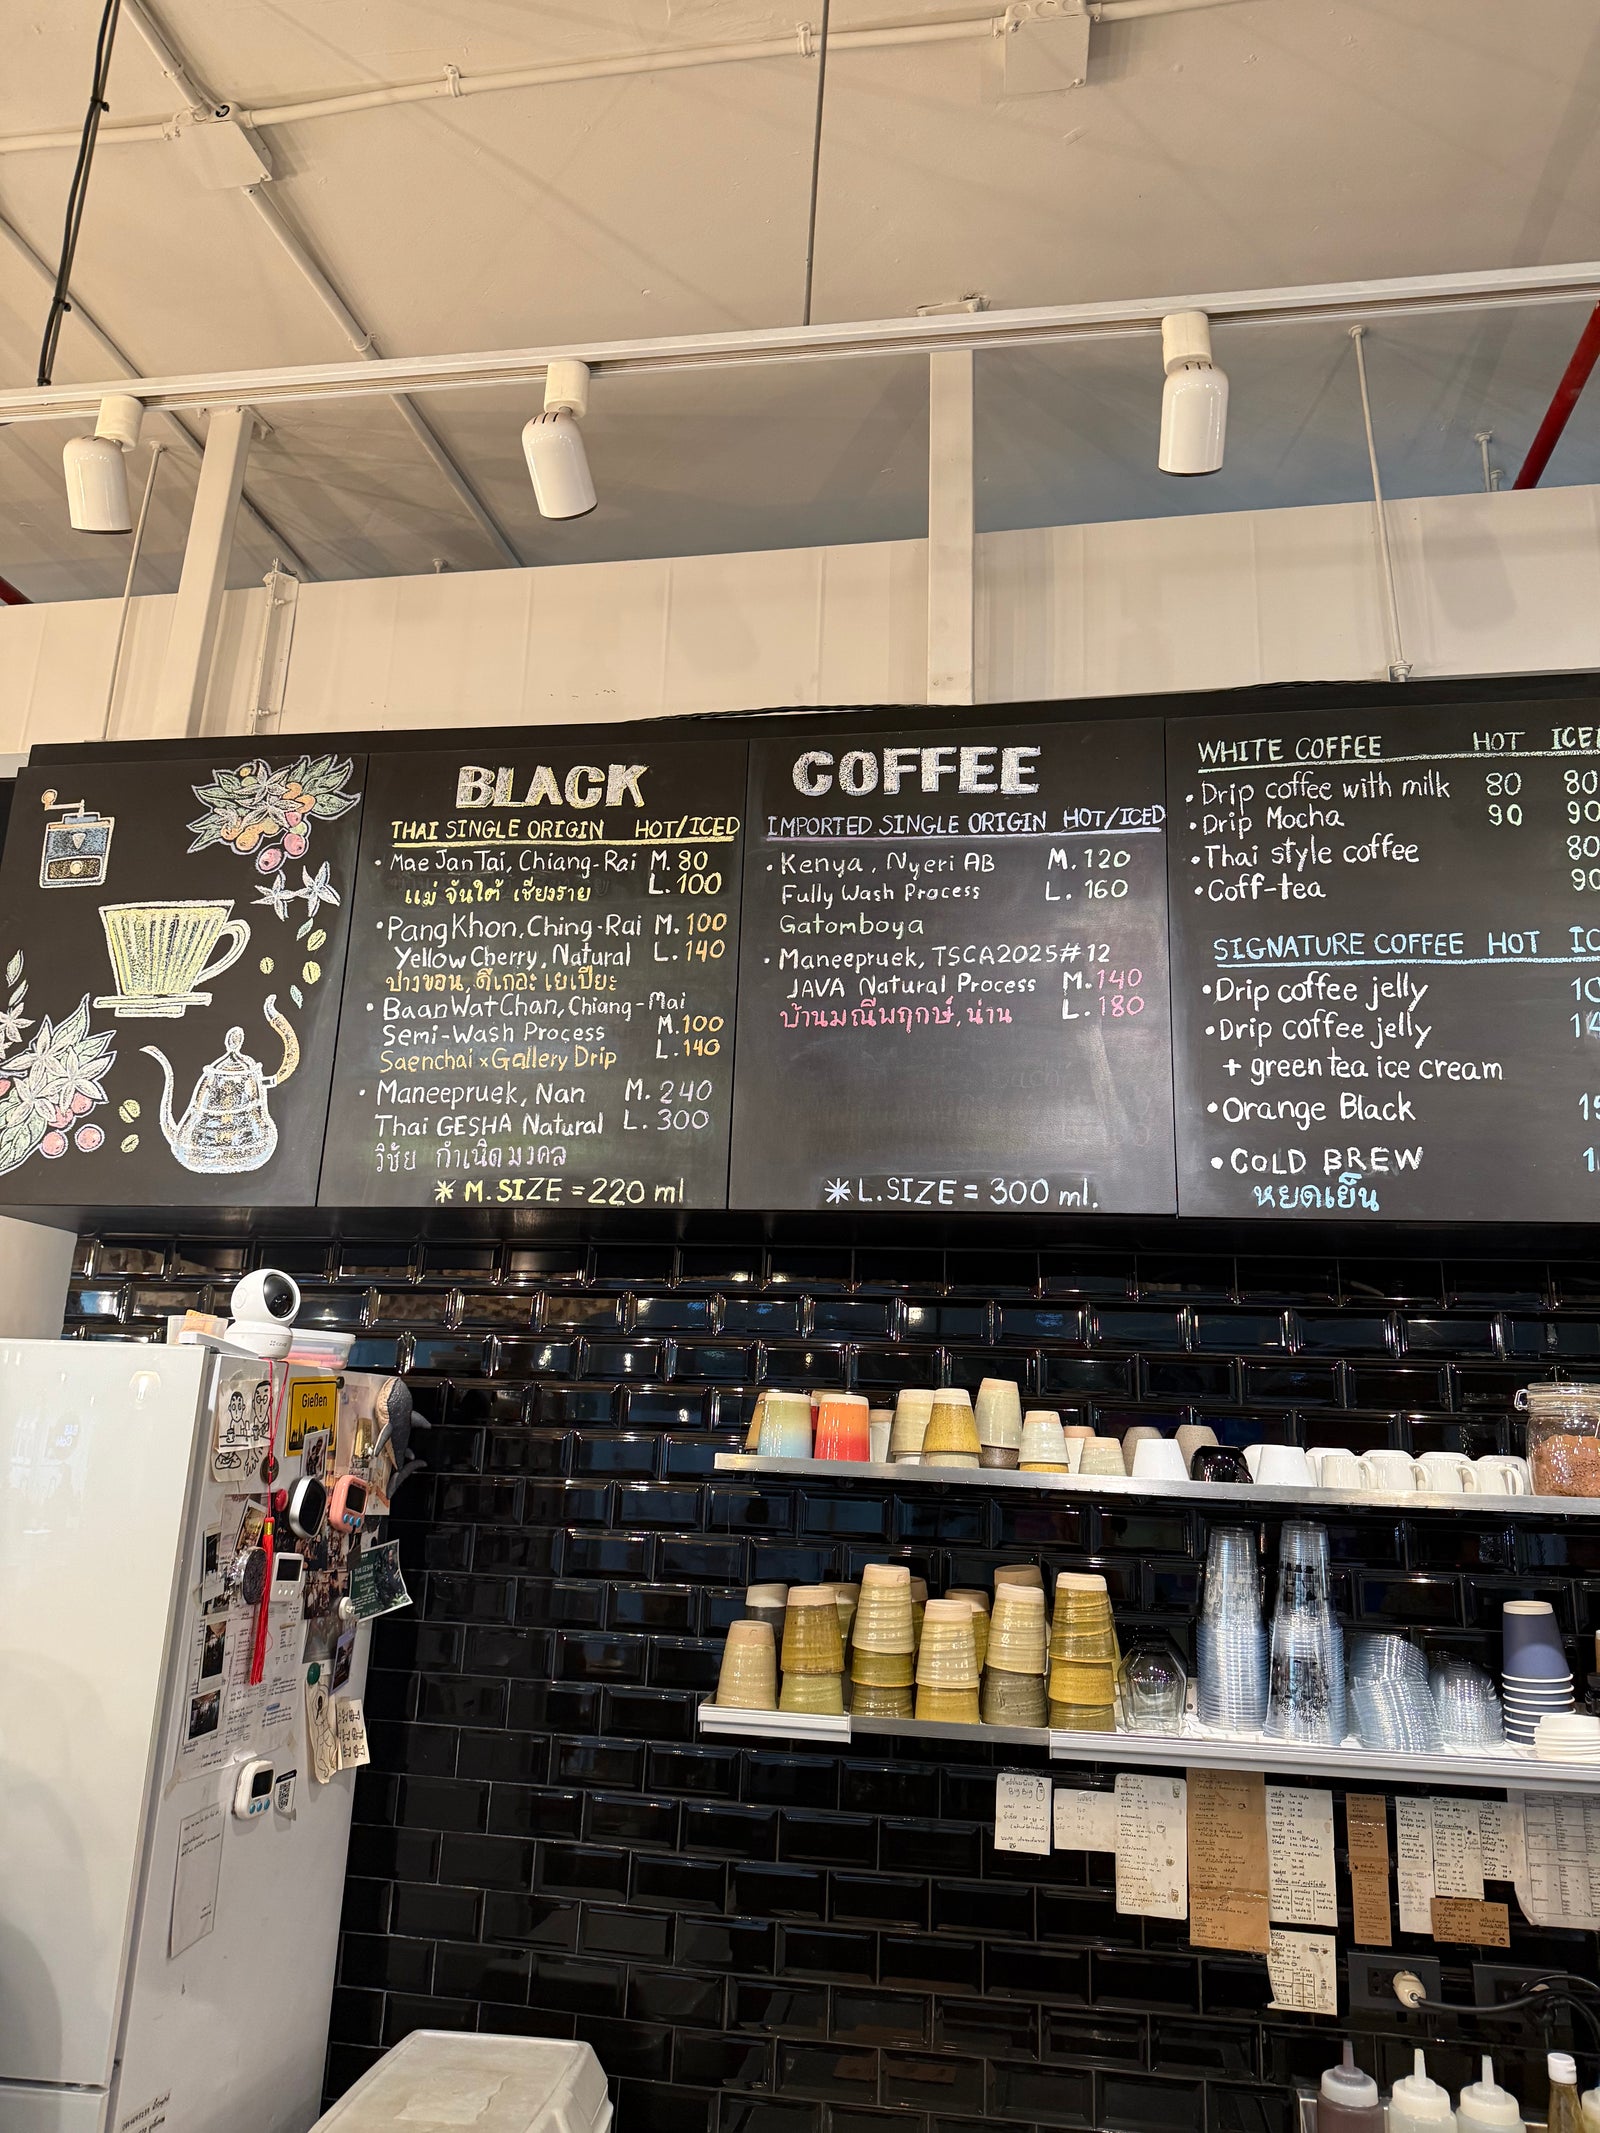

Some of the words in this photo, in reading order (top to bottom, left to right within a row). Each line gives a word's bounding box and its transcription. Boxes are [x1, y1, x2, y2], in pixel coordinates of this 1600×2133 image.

[1197, 737, 1284, 764] WHITE
[1295, 734, 1382, 761] COFFEE
[1472, 731, 1526, 752] HOT
[791, 745, 1042, 797] COFFEE
[1485, 771, 1522, 797] 80
[1563, 769, 1599, 795] 80
[455, 763, 650, 810] BLACK
[1201, 780, 1255, 818] Drip
[1265, 770, 1333, 801] coffee
[1342, 770, 1392, 800] with
[1401, 768, 1451, 799] milk
[767, 815, 873, 837] IMPORTED
[878, 814, 960, 836] SINGLE
[967, 810, 1047, 834] ORIGIN
[1062, 803, 1167, 830] HOT/ICED
[1202, 811, 1253, 840] Drip
[1266, 802, 1345, 831] Mocha
[1487, 803, 1523, 827] 90
[1566, 799, 1600, 825] 90
[390, 820, 440, 841] THAI
[445, 818, 521, 840] SINGLE
[527, 819, 604, 840] ORIGIN
[634, 814, 741, 839] HOT/ICED
[678, 849, 709, 872] 80
[1083, 848, 1131, 870] 120
[1204, 843, 1259, 870] Thai
[1270, 833, 1333, 873] style
[1342, 831, 1420, 864] coffee
[1566, 834, 1600, 861] 80
[389, 853, 430, 872] Mae
[886, 851, 955, 881] Nyeri
[963, 852, 995, 873] AB
[513, 875, 592, 903] เชียงราย
[676, 871, 722, 895] 100
[781, 882, 834, 910] Fully
[841, 882, 895, 902] Wash
[904, 882, 981, 902] Process
[1084, 878, 1129, 899] 160
[1207, 872, 1327, 903] Coff-tea
[686, 912, 728, 936] 100
[779, 911, 924, 940] Gatomboya
[685, 938, 726, 963] 140
[1213, 931, 1366, 961] SIGNATURE
[1373, 932, 1464, 957] COFFEE
[1488, 930, 1541, 956] HOT
[393, 945, 467, 975] Yellow
[552, 941, 631, 968] Natural
[778, 945, 925, 975] Maneepruek,
[786, 977, 846, 999] JAVA
[858, 974, 946, 996] Natural
[957, 972, 1037, 994] Process
[1096, 968, 1143, 990] 140
[1213, 977, 1270, 1013] Drip
[1277, 970, 1358, 1004] coffee
[1365, 971, 1429, 1012] jelly
[966, 998, 1013, 1025] น่าน
[1098, 994, 1145, 1018] 180
[523, 1021, 605, 1042] Process
[1219, 1017, 1273, 1048] Drip
[1282, 1008, 1365, 1041] coffee
[1369, 1007, 1433, 1050] jelly
[379, 1047, 473, 1074] Saenchai
[574, 1043, 617, 1071] Drip
[1222, 1058, 1242, 1077] +
[1250, 1057, 1323, 1087] green
[1326, 1046, 1369, 1079] tea
[1376, 1055, 1411, 1079] ice
[1418, 1058, 1503, 1081] cream
[376, 1079, 528, 1111] Maneepruek,
[535, 1082, 586, 1105] Nan
[659, 1079, 713, 1105] 240
[656, 1108, 710, 1131] 300
[1222, 1096, 1327, 1131] Orange
[1339, 1090, 1417, 1122] Black
[374, 1113, 429, 1138] Thai
[436, 1112, 512, 1137] GESHA
[522, 1111, 604, 1137] Natural
[1230, 1147, 1307, 1175] COLD
[1323, 1146, 1424, 1176] BREW
[1582, 1146, 1600, 1173] 1
[654, 1177, 684, 1204] ml
[989, 1177, 1050, 1206] 300
[1058, 1177, 1099, 1209] ml.
[302, 1392, 328, 1408] Gießen
